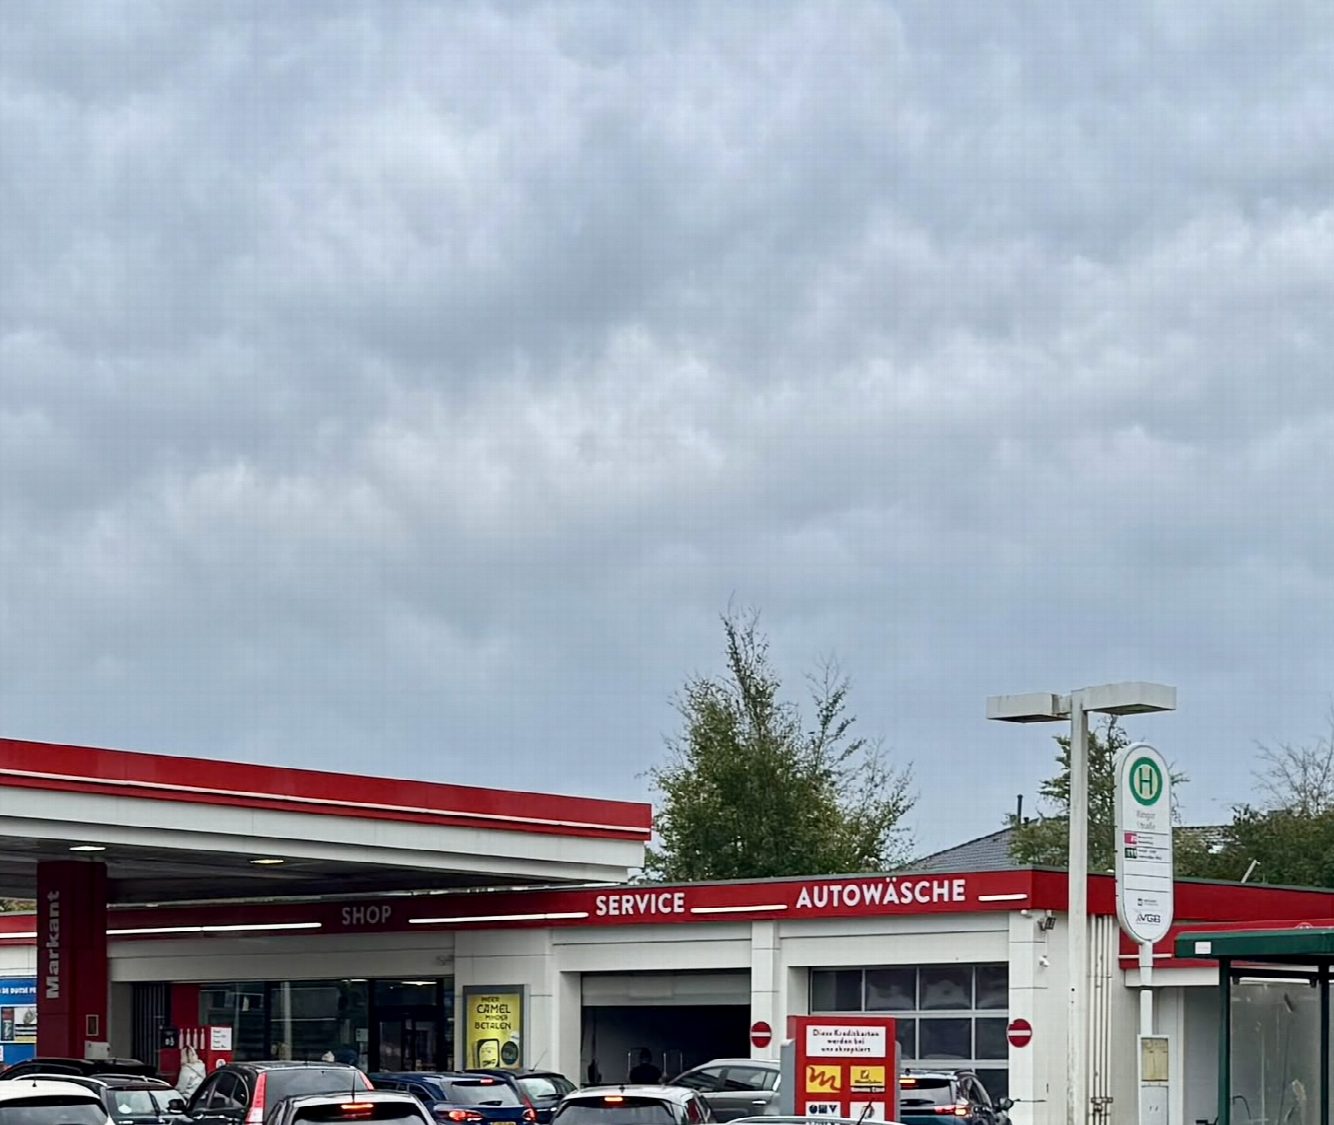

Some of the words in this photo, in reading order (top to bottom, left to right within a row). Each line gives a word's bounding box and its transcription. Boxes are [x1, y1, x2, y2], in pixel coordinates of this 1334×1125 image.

[796, 877, 966, 909] AUTOWÄSCHE
[341, 905, 392, 925] SHOP
[596, 893, 685, 916] SERVICE
[46, 891, 60, 999] Markant
[476, 1003, 511, 1014] CAMEL
[813, 1028, 832, 1036] Diese
[834, 1029, 879, 1037] Kreditkarten
